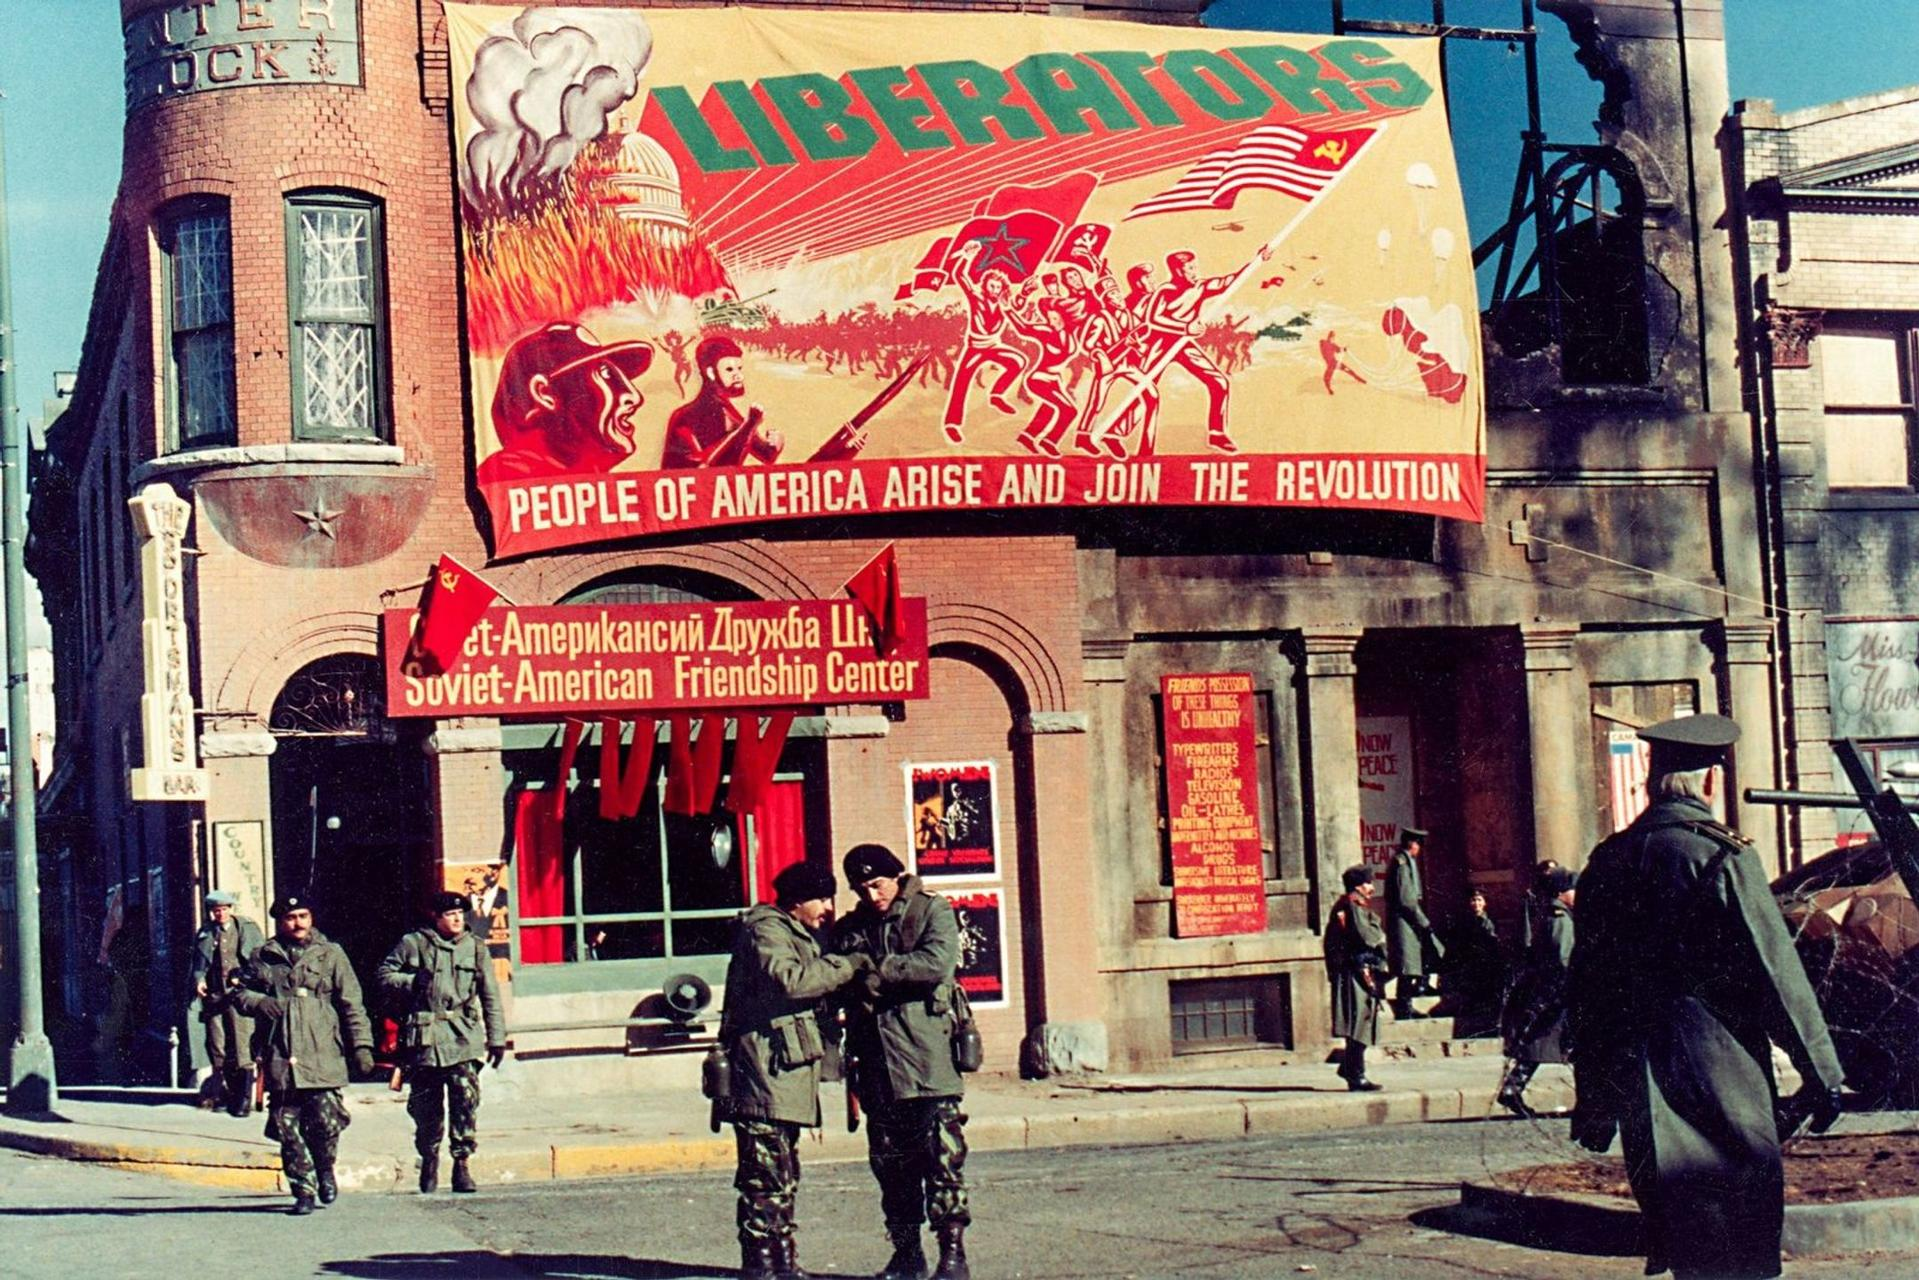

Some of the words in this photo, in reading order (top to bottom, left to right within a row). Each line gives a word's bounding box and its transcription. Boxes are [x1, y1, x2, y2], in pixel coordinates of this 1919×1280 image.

[650, 40, 1433, 173] LIBERATORS
[508, 480, 638, 532] PEOPLE
[655, 477, 696, 520] OF
[711, 467, 868, 518] AMERICA
[883, 463, 982, 508] ARISE
[999, 463, 1065, 504] AND
[1084, 463, 1161, 503] JOIN
[1190, 461, 1248, 501] THE
[1276, 460, 1460, 502] REVOLUTION
[708, 606, 820, 656] Дружба
[405, 659, 653, 708] Soviet-American
[674, 653, 818, 702] Friendship
[826, 651, 919, 693] Center
[1172, 742, 1239, 756] TYPEWRITERS
[1360, 734, 1392, 752] NOW
[1187, 755, 1239, 768] FIREARMS
[1359, 754, 1398, 776] PEACE
[1193, 767, 1233, 780] RADIOS
[1186, 778, 1242, 792] TELEVISION
[1187, 791, 1239, 805] GASOLINE
[1366, 823, 1396, 842] NOW
[1190, 842, 1237, 855] ALCOHOL
[222, 826, 261, 908] COUNTRY
[1203, 853, 1236, 865] DRUGS
